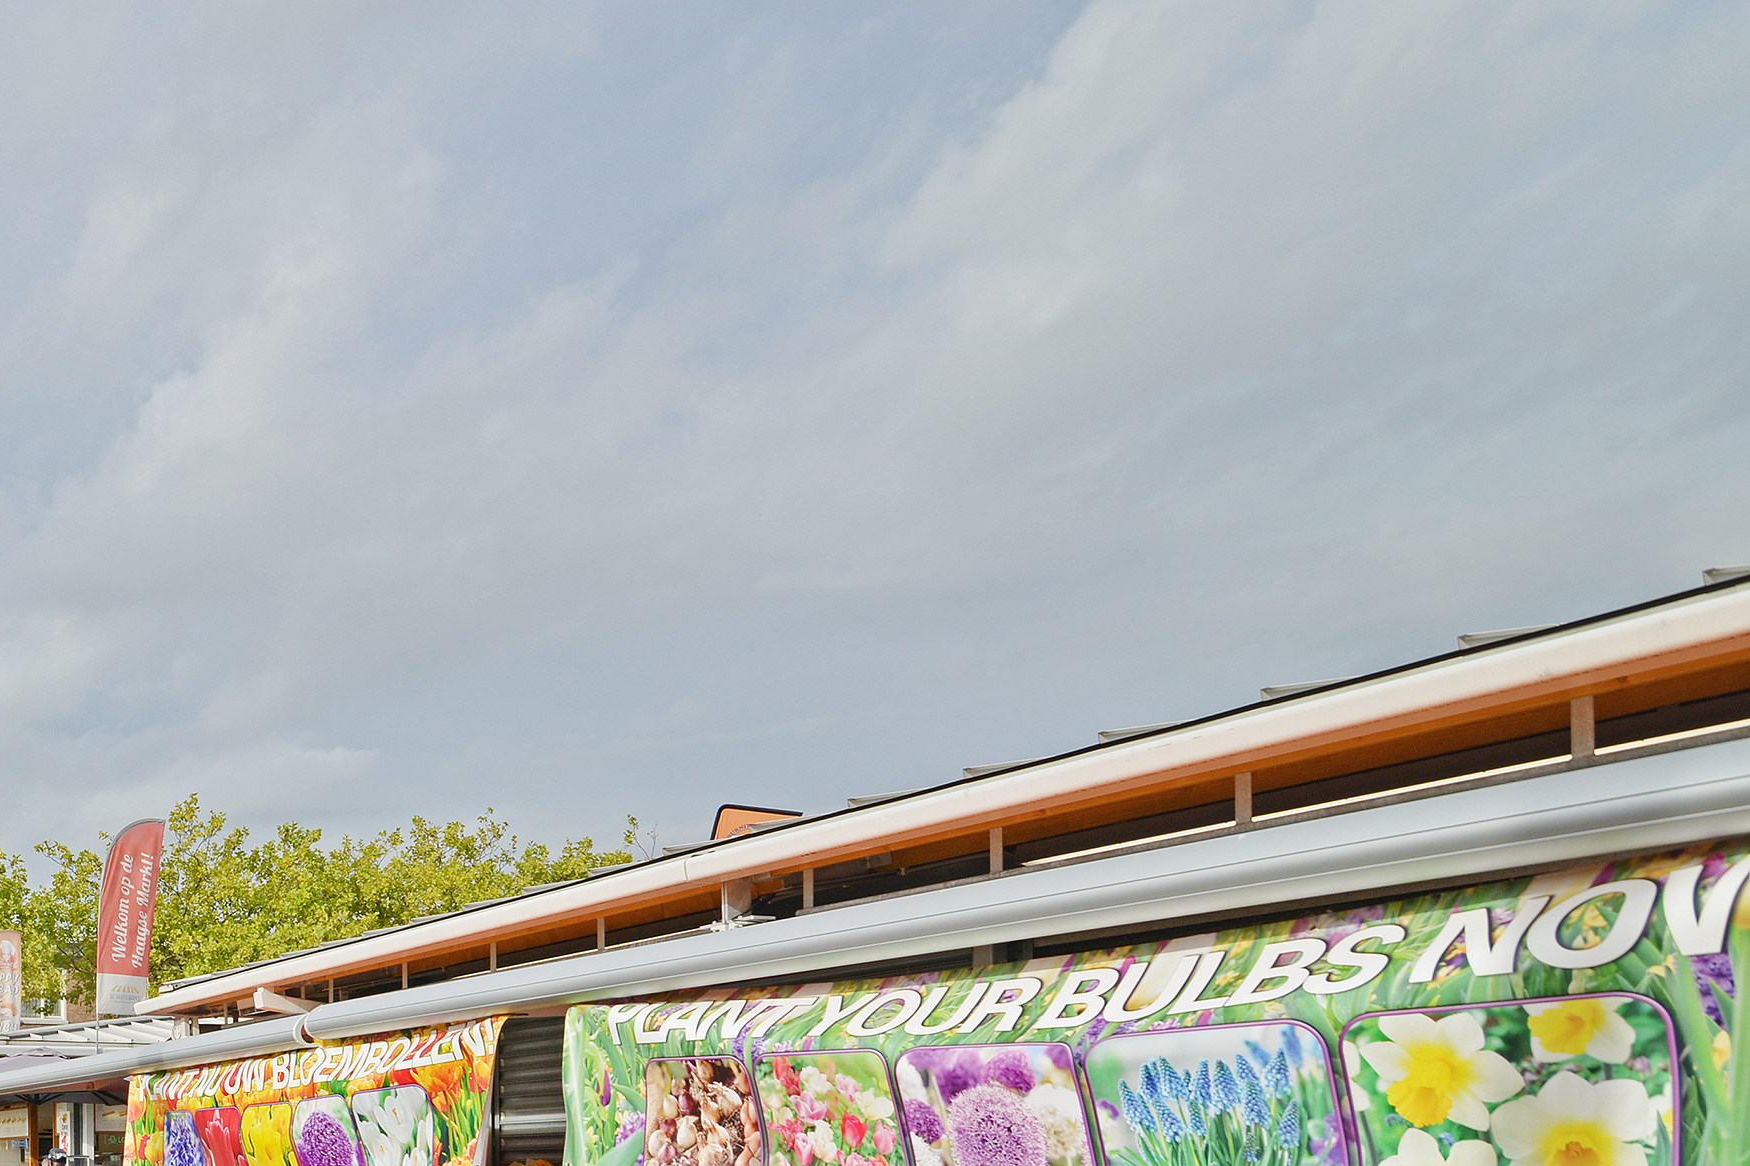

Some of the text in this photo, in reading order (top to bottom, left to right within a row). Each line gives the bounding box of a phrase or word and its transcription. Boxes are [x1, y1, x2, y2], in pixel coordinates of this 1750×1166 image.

[112, 853, 135, 963] Welkom op de
[132, 852, 154, 969] Haagse Markt!
[607, 997, 818, 1046] PLANT
[809, 976, 1043, 1038] YOUR
[1036, 924, 1407, 1030] BULBS
[271, 1017, 495, 1089] BLOEMBOLLEN!
